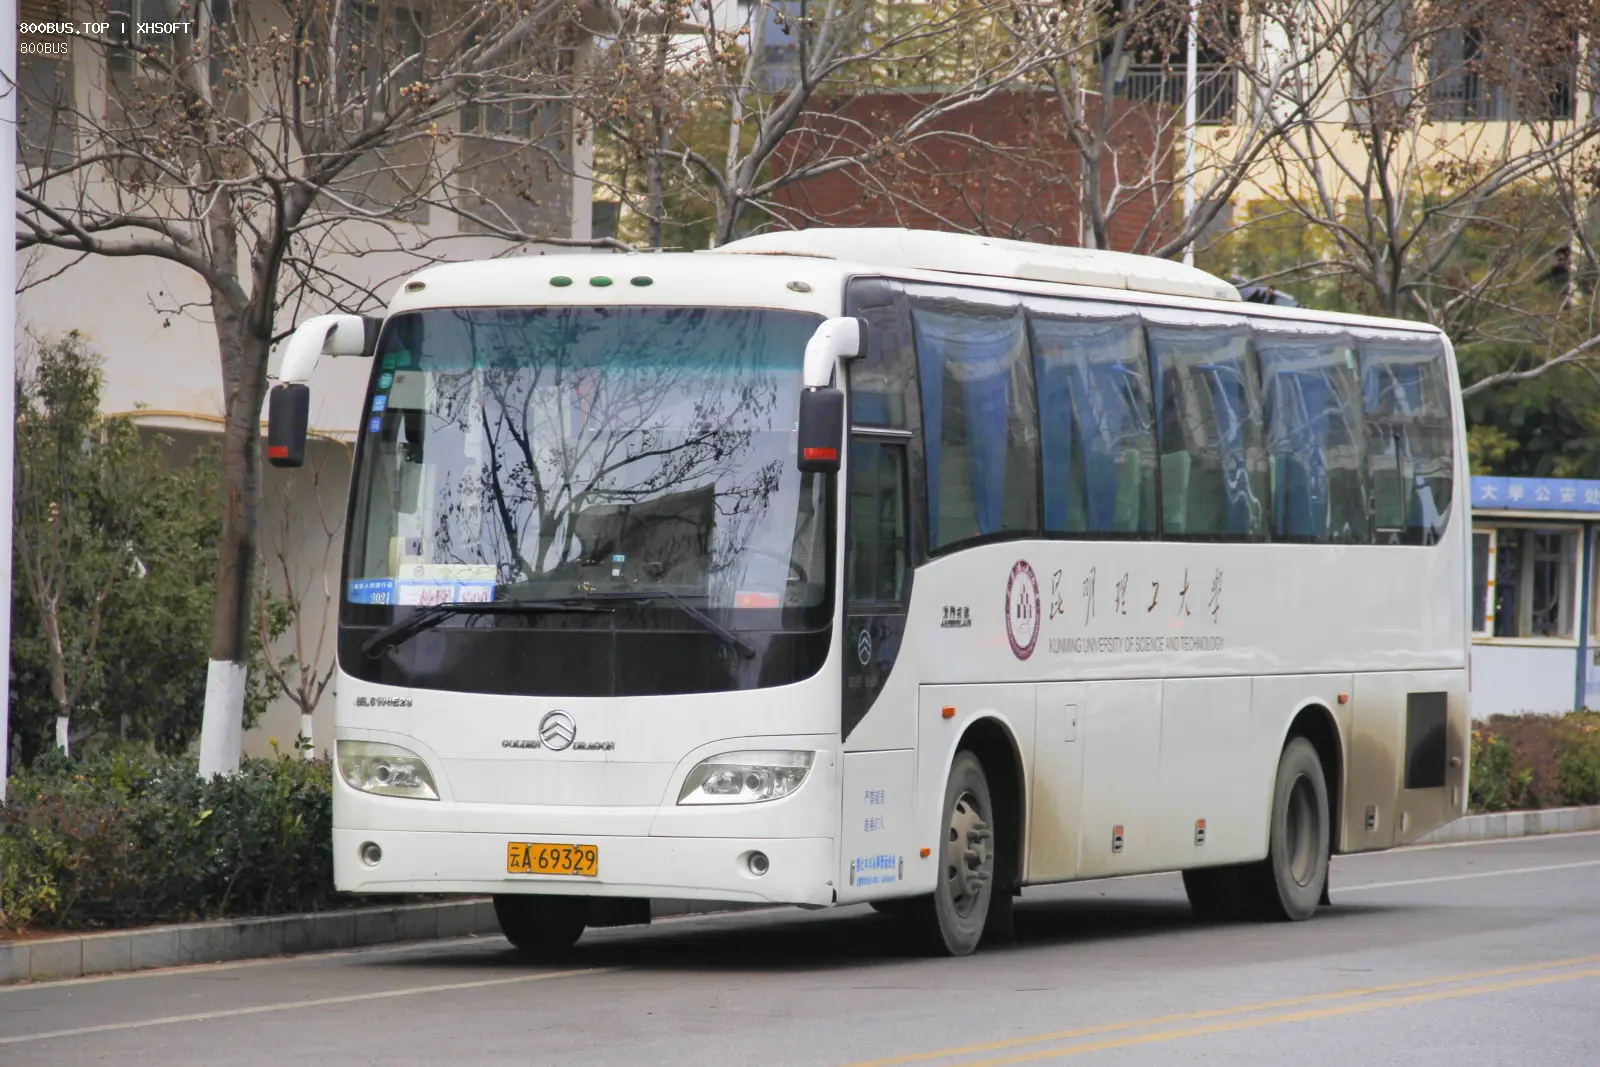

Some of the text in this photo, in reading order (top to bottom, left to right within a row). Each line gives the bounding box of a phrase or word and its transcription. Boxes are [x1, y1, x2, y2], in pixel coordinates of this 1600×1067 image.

[370, 592, 391, 606] 2021
[1049, 636, 1225, 654] KUNMING UNIVERSITY OF SCIENCE AND TECHNOLOGY
[510, 846, 596, 871] 云A·69329
